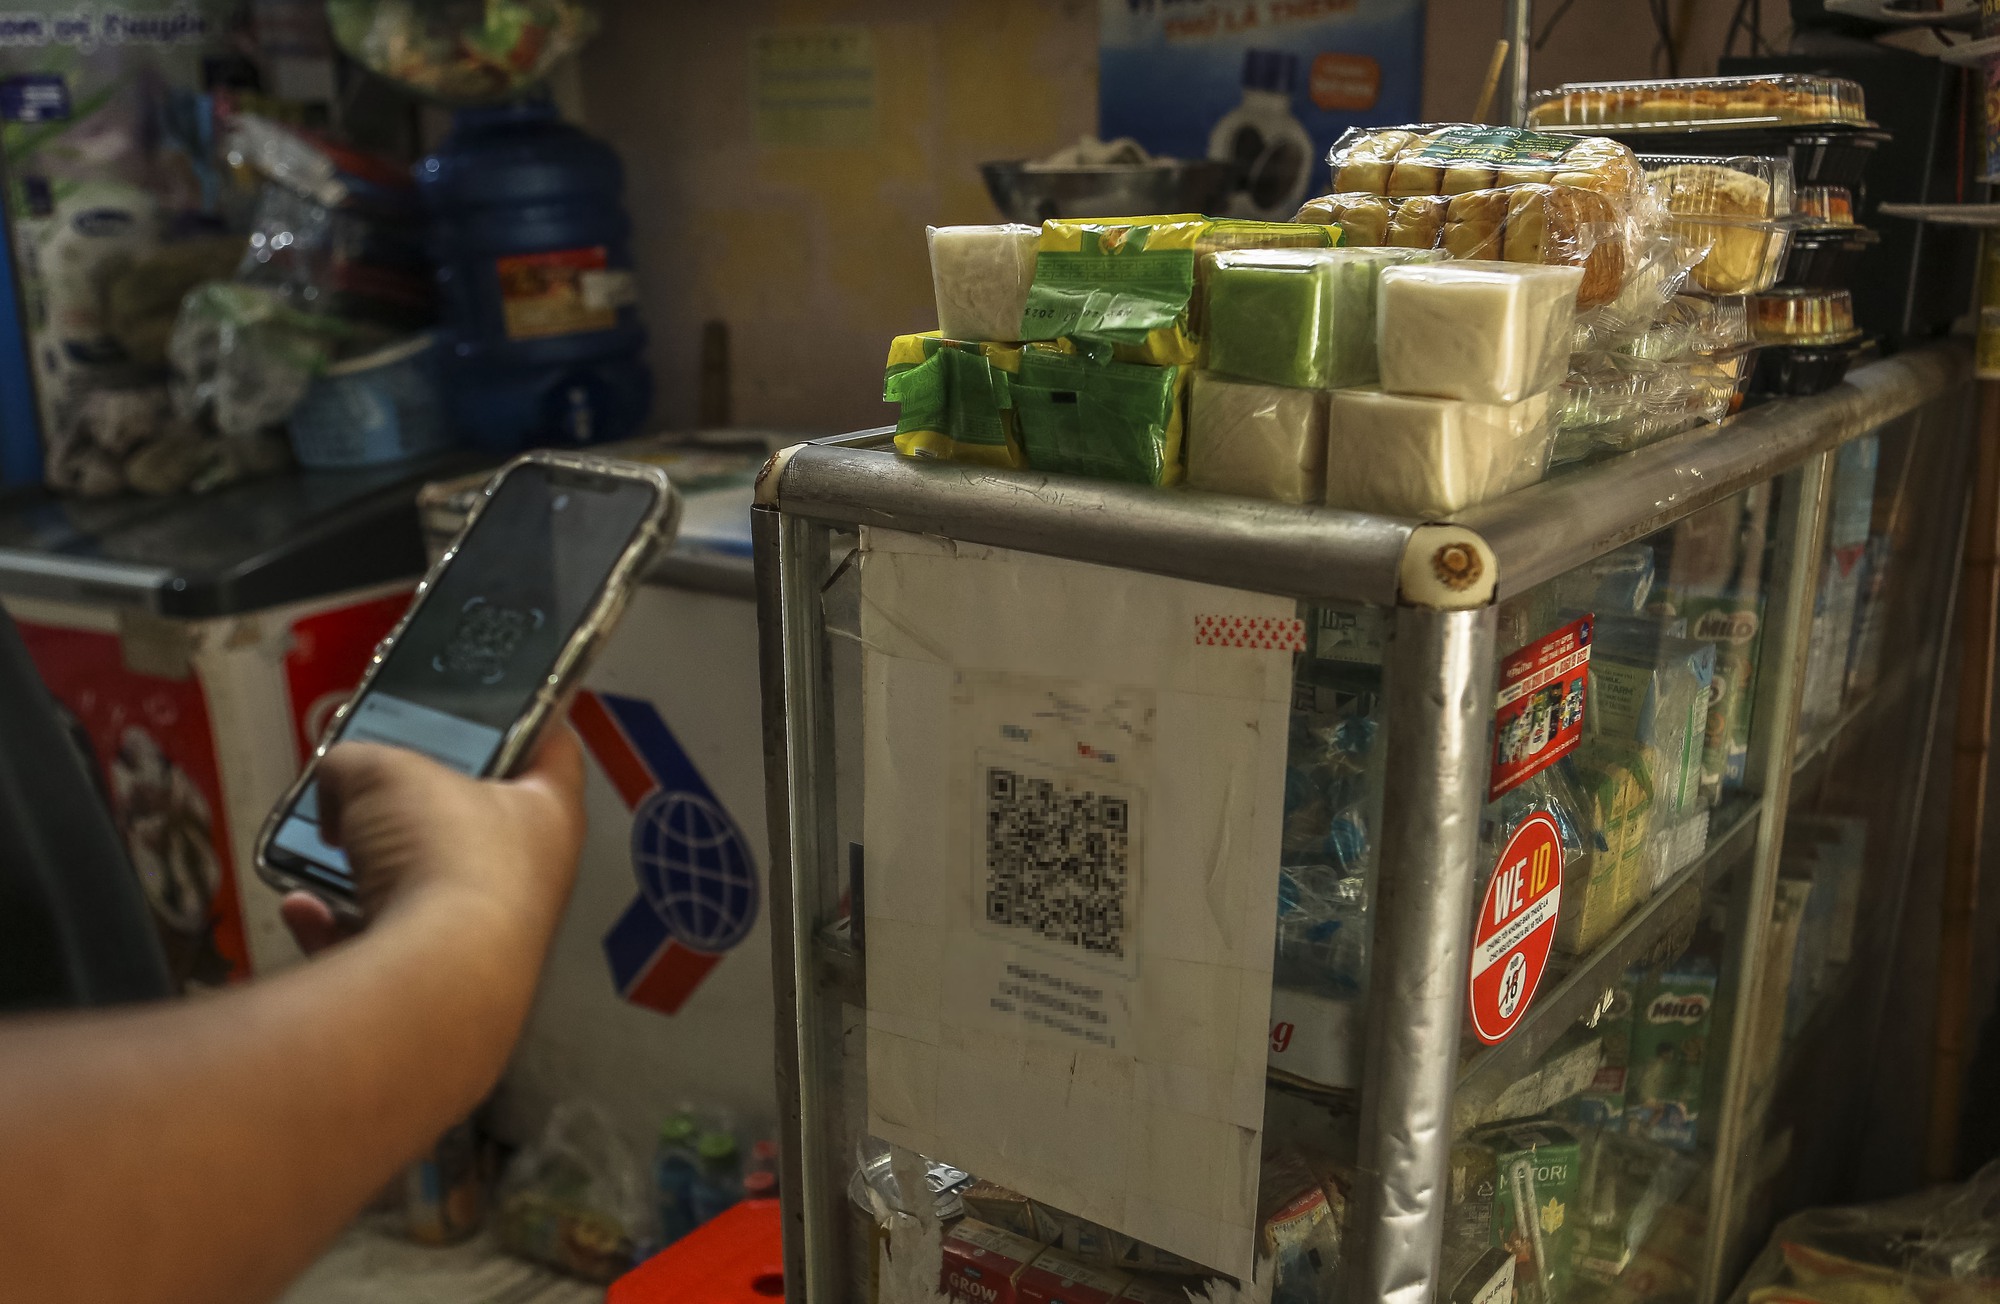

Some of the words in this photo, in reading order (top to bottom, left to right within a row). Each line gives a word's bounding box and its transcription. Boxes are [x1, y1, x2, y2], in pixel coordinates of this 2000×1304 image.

[1494, 857, 1528, 926] WE
[1529, 841, 1552, 899] ID
[1652, 1001, 1704, 1018] MILO
[949, 1271, 999, 1303] GROW
